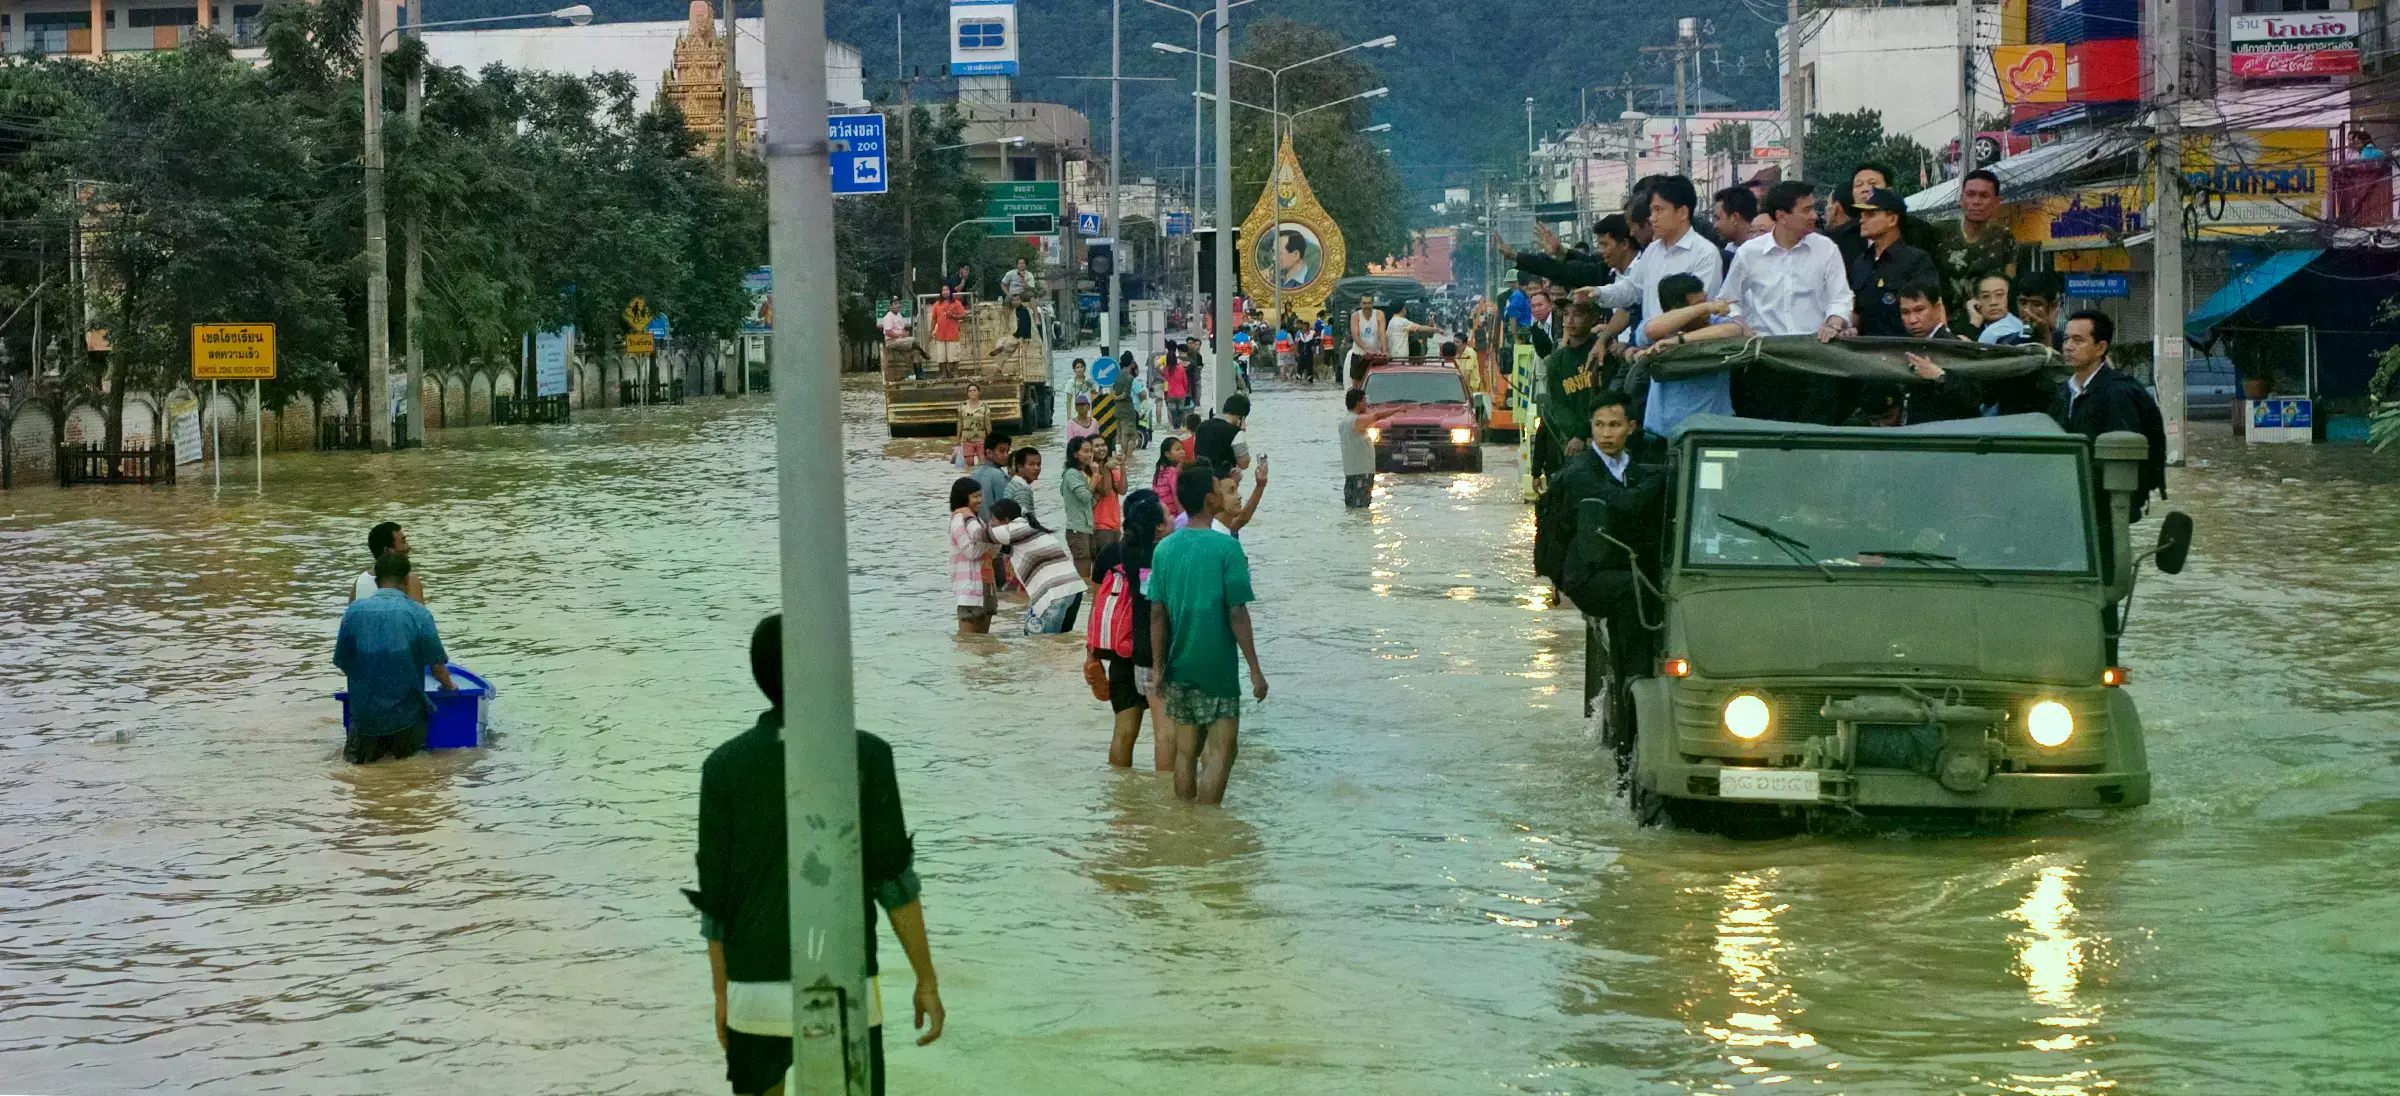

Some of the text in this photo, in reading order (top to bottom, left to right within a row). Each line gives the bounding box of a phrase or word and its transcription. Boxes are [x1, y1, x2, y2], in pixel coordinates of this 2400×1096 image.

[857, 141, 878, 152] ZOO
[201, 328, 264, 344] เขตโรงเรียน
[208, 345, 260, 360] ลดความเร็ว
[198, 366, 217, 374] SCHOOL
[254, 366, 271, 374] SPEED
